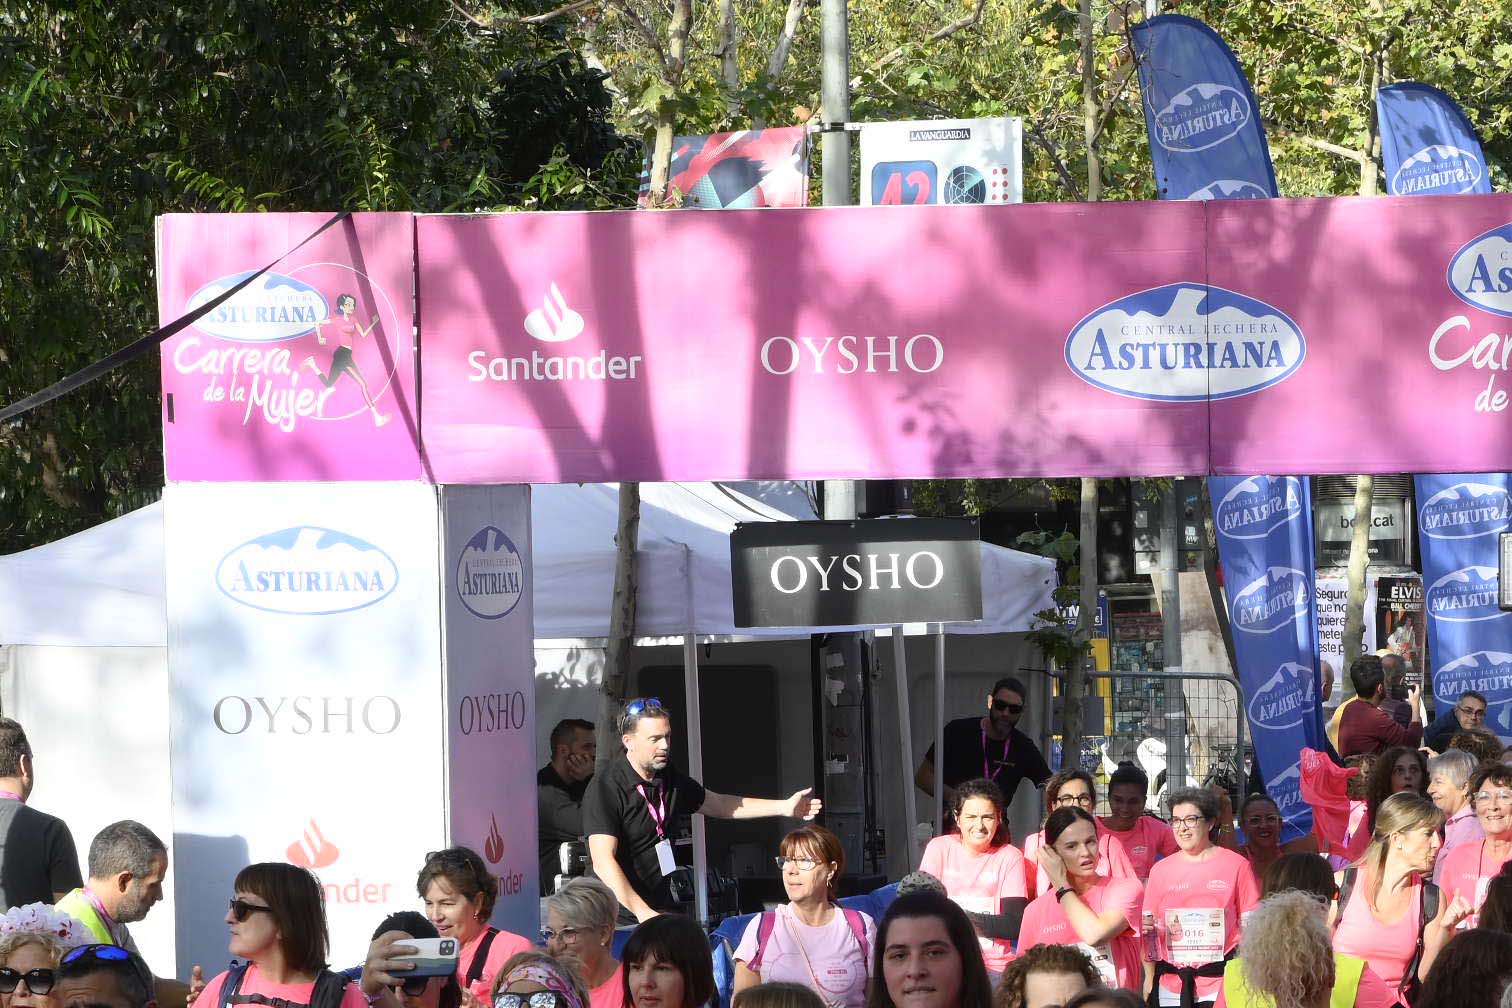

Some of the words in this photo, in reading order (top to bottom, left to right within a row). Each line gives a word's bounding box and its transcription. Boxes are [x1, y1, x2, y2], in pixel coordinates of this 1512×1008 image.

[920, 128, 970, 141] VANGUARDIA
[1120, 324, 1195, 336] CENTRAL
[1204, 321, 1279, 335] LECHERA
[174, 338, 291, 375] Carrera
[467, 348, 643, 382] Santander
[760, 333, 945, 376] OYSHO
[1083, 327, 1288, 370] ASTURIANA
[203, 377, 225, 402] de
[230, 375, 246, 401] la
[243, 371, 337, 432] Mujer
[1474, 373, 1509, 412] de
[231, 559, 385, 593] ASTURIANA
[461, 560, 520, 596] ASTURIANA
[770, 550, 944, 594] OYSHO
[1391, 586, 1422, 599] ELVIS
[213, 695, 401, 735] OYSHO
[459, 690, 525, 736] OYSHO
